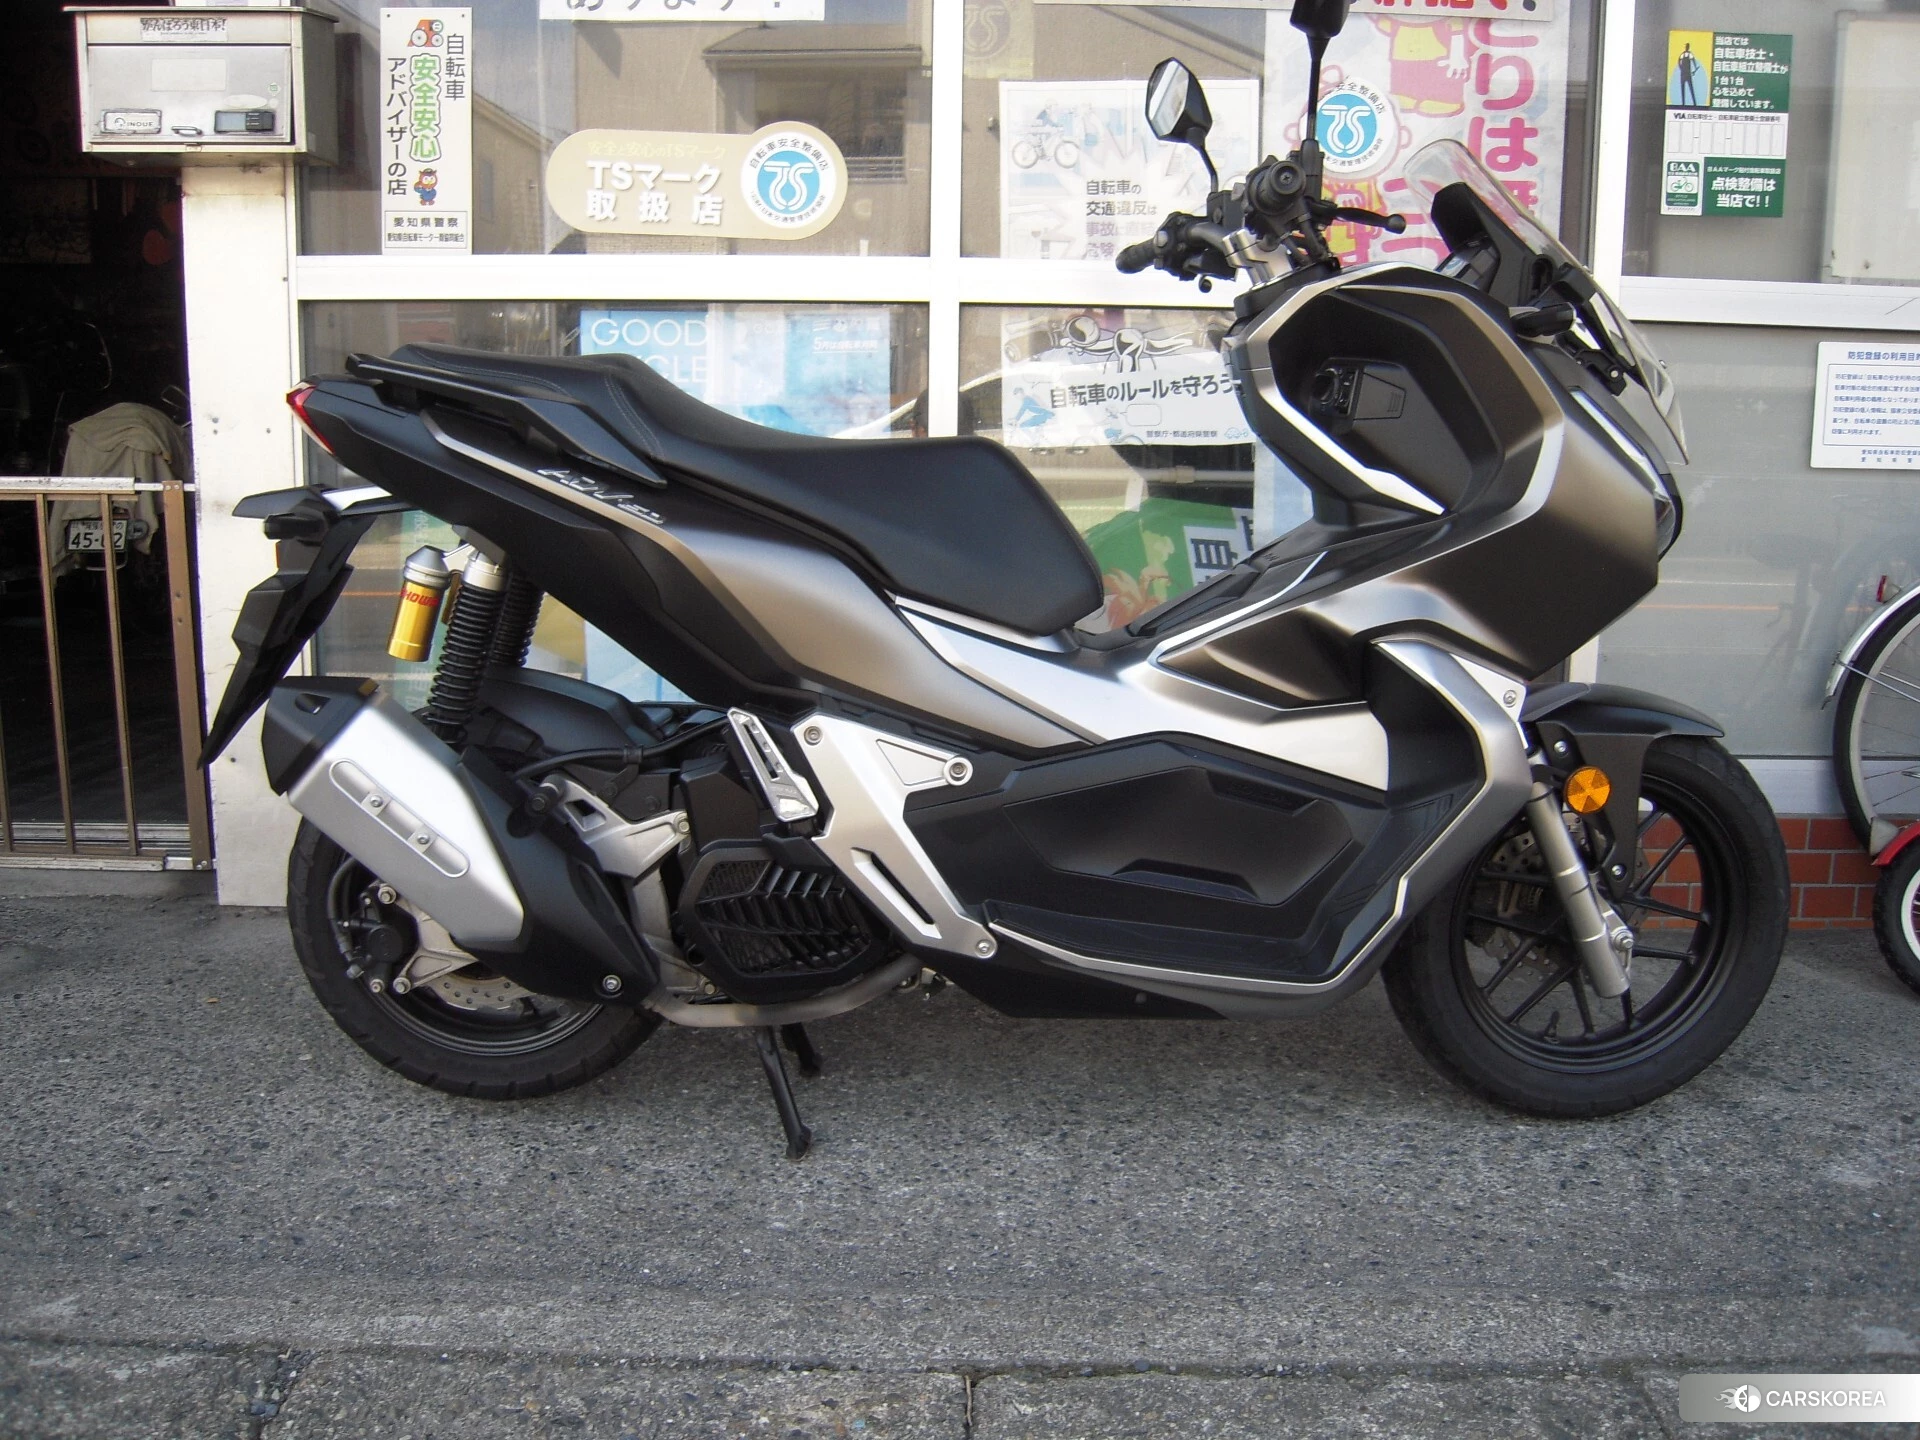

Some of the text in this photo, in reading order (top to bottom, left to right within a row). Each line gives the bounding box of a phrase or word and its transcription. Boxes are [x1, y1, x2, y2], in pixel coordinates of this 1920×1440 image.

[445, 34, 465, 101] 自転車
[1712, 87, 1755, 97] 心を込めて
[413, 57, 436, 158] 安全安心
[387, 57, 407, 196] アドバイザーの店
[586, 160, 722, 195] TSマーク
[1086, 180, 1142, 196] 自転車の
[1711, 177, 1777, 192] 点検整備は
[586, 189, 723, 226] 取扱店
[1086, 200, 1157, 216] 交通違反は
[393, 217, 458, 228] 愛知県警察
[591, 318, 708, 346] GOOD
